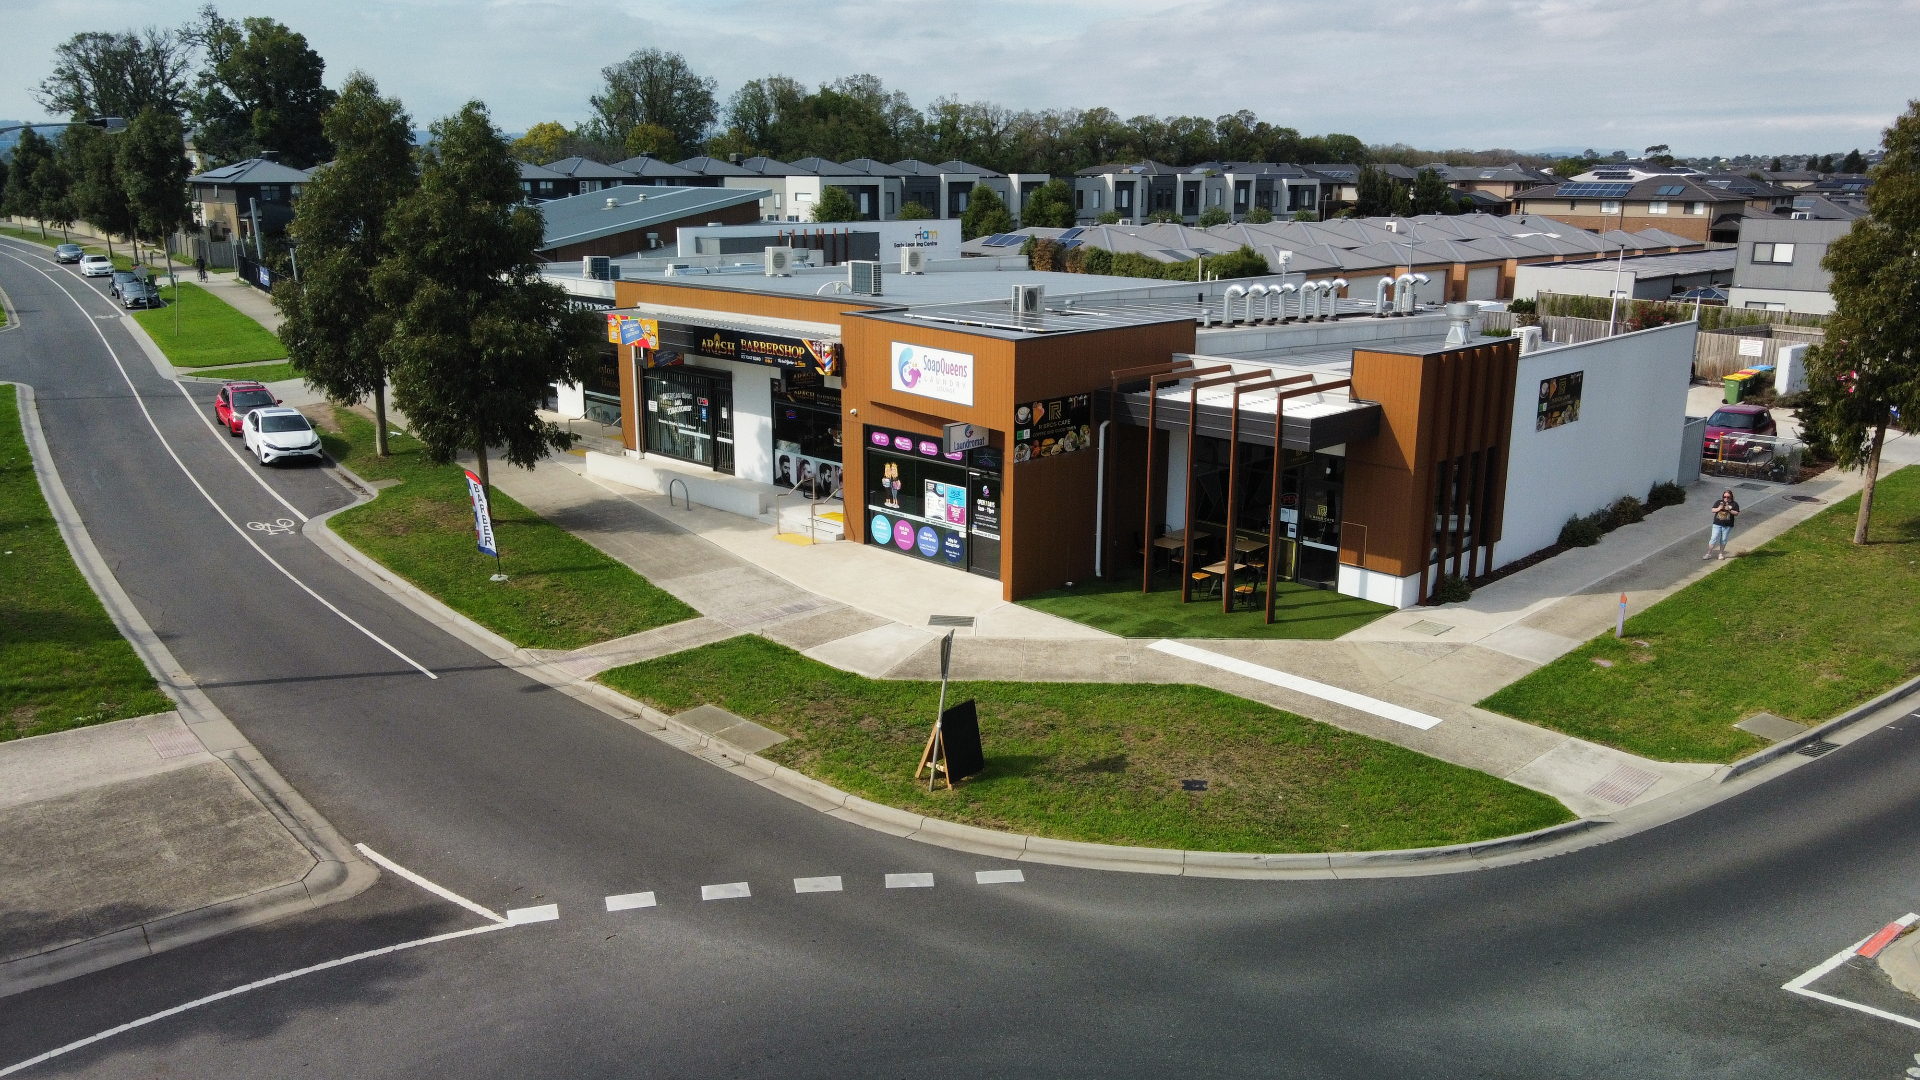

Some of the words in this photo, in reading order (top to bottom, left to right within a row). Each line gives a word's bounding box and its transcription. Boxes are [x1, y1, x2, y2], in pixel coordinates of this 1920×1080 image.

[701, 332, 735, 355] ARASH
[740, 338, 806, 359] BARBERSHOP
[923, 354, 968, 378] SoapQueens
[923, 375, 967, 389] LAUNDRY
[936, 386, 956, 395] LOUNGE
[953, 436, 985, 450] Laundromat
[473, 483, 493, 546] BARBER
